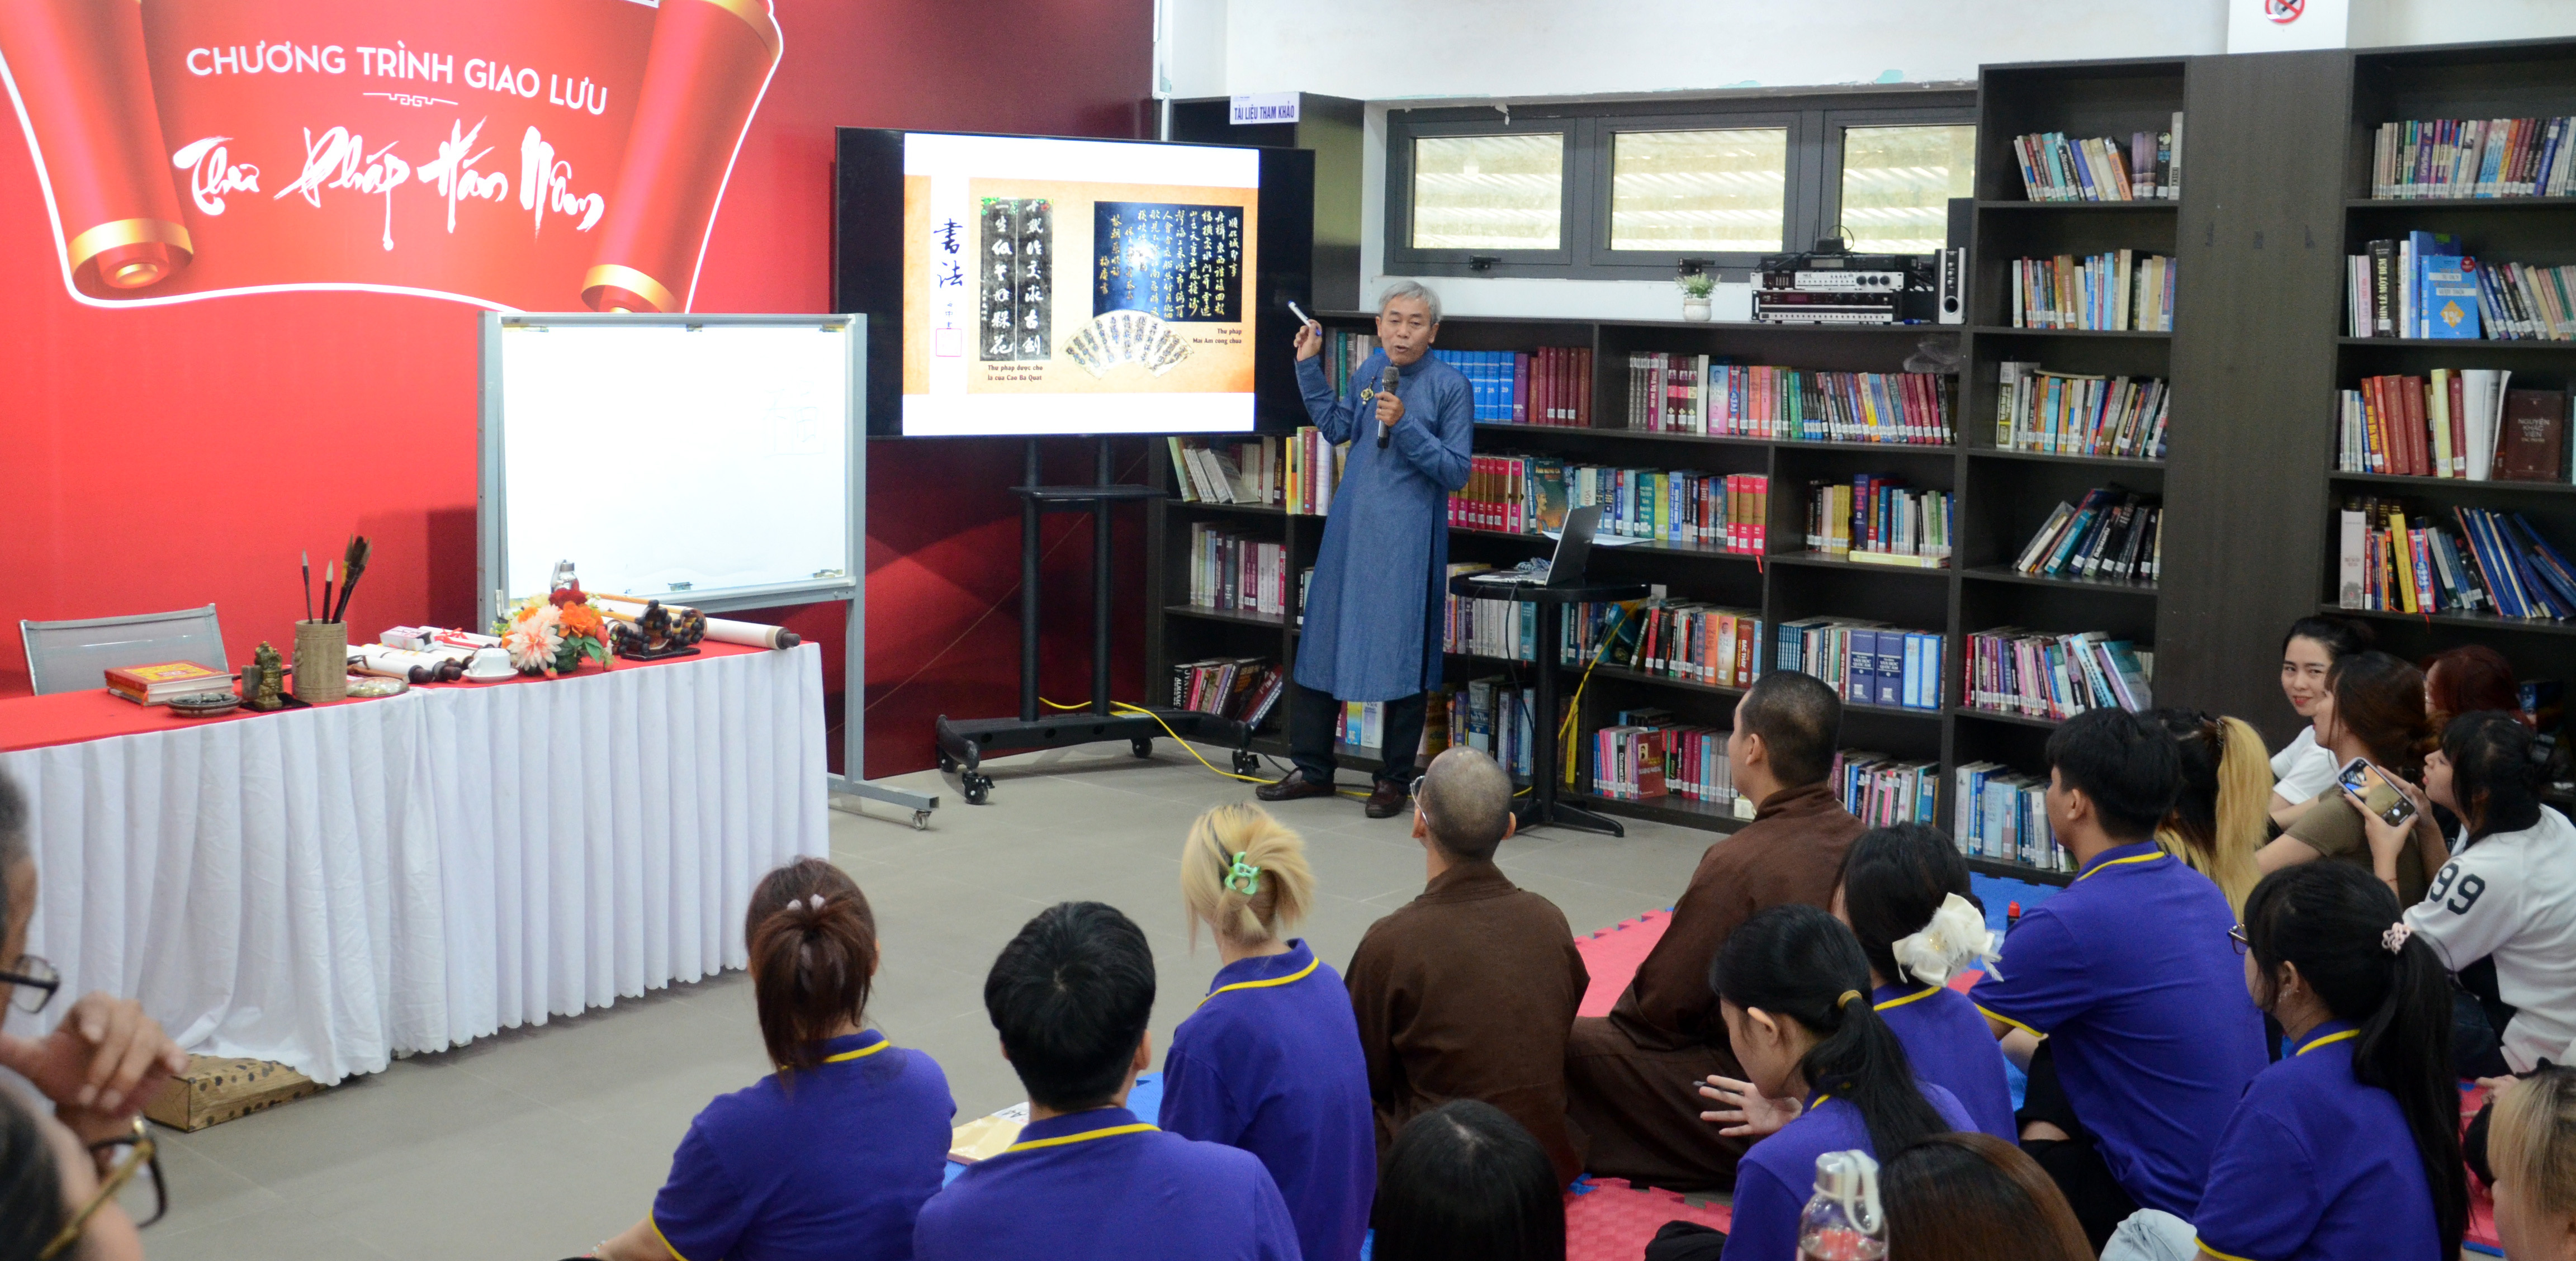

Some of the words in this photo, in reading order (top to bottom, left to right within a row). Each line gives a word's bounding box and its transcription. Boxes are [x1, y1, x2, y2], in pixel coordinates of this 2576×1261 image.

[187, 40, 346, 74] CHƯƠNG
[356, 39, 453, 84] TRÌNH
[464, 58, 540, 98] GIAO
[550, 73, 607, 115] LƯU
[1234, 105, 1243, 120] TÀI
[1245, 104, 1258, 122] LIỆU
[1259, 106, 1276, 119] THAM
[1278, 101, 1295, 118] KHẢO
[173, 136, 260, 216] Thư
[2430, 862, 2485, 916] 99
